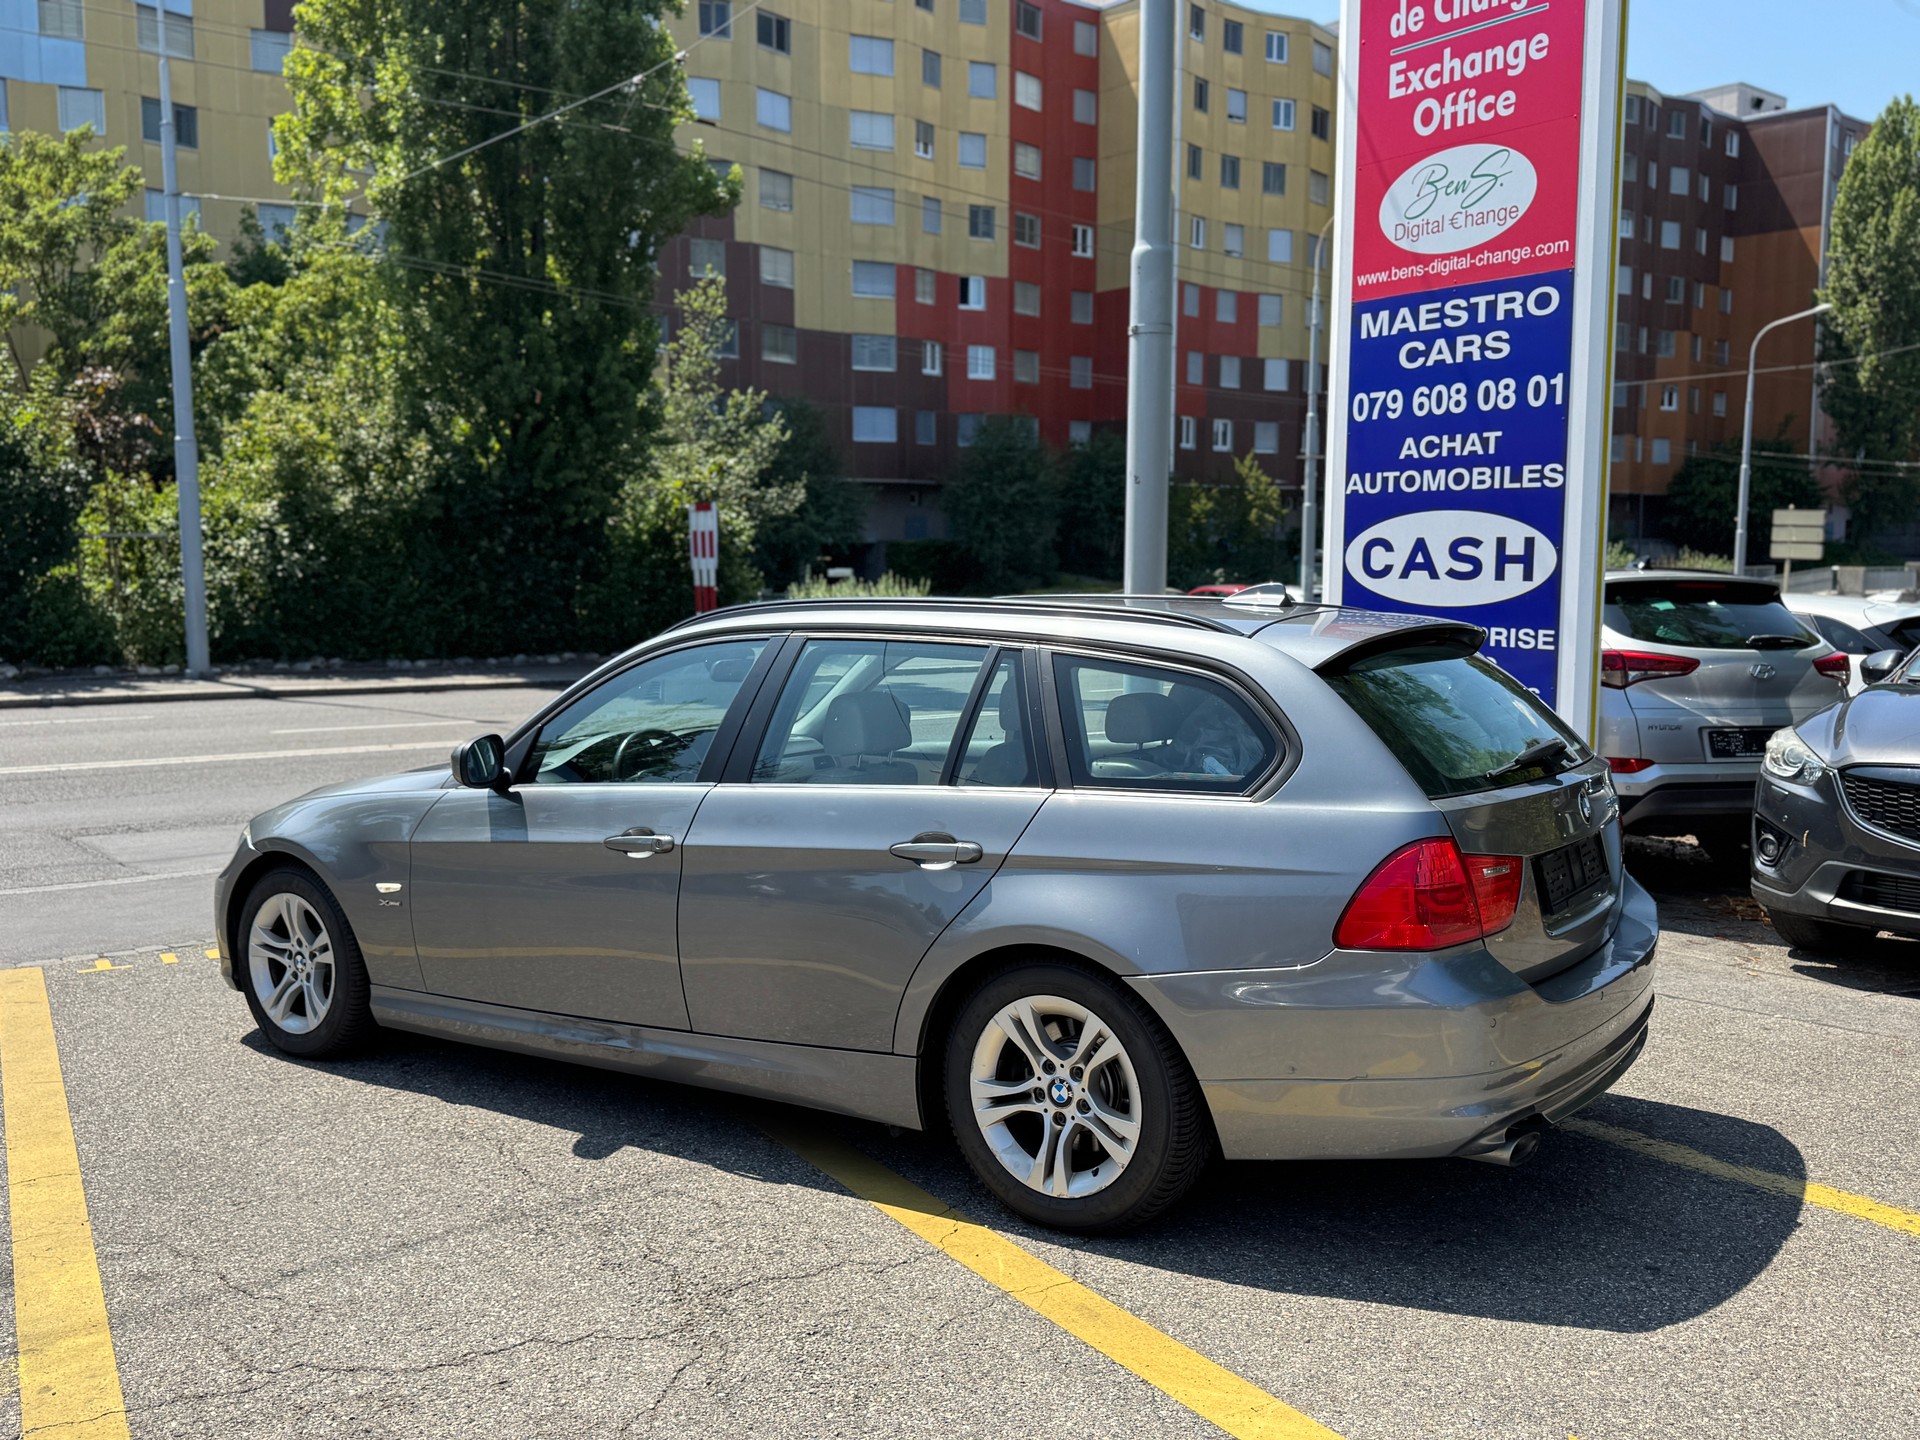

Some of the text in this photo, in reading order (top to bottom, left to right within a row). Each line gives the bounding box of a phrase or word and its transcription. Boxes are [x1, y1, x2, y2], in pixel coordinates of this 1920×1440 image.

[1390, 0, 1425, 38] de
[1389, 32, 1549, 99] Exchange
[1413, 90, 1516, 136] Office
[1394, 215, 1445, 243] Digital
[1357, 239, 1569, 286] www.bens-digital-change.com
[1360, 286, 1560, 339] MAESTRO
[1398, 330, 1511, 369] CARS
[1352, 372, 1564, 422] 079 608 08 01
[1399, 431, 1502, 459] ACHAT
[1345, 463, 1565, 494] AUTOMOBILES
[1361, 536, 1536, 582] CASH
[1482, 626, 1555, 650] RISE
